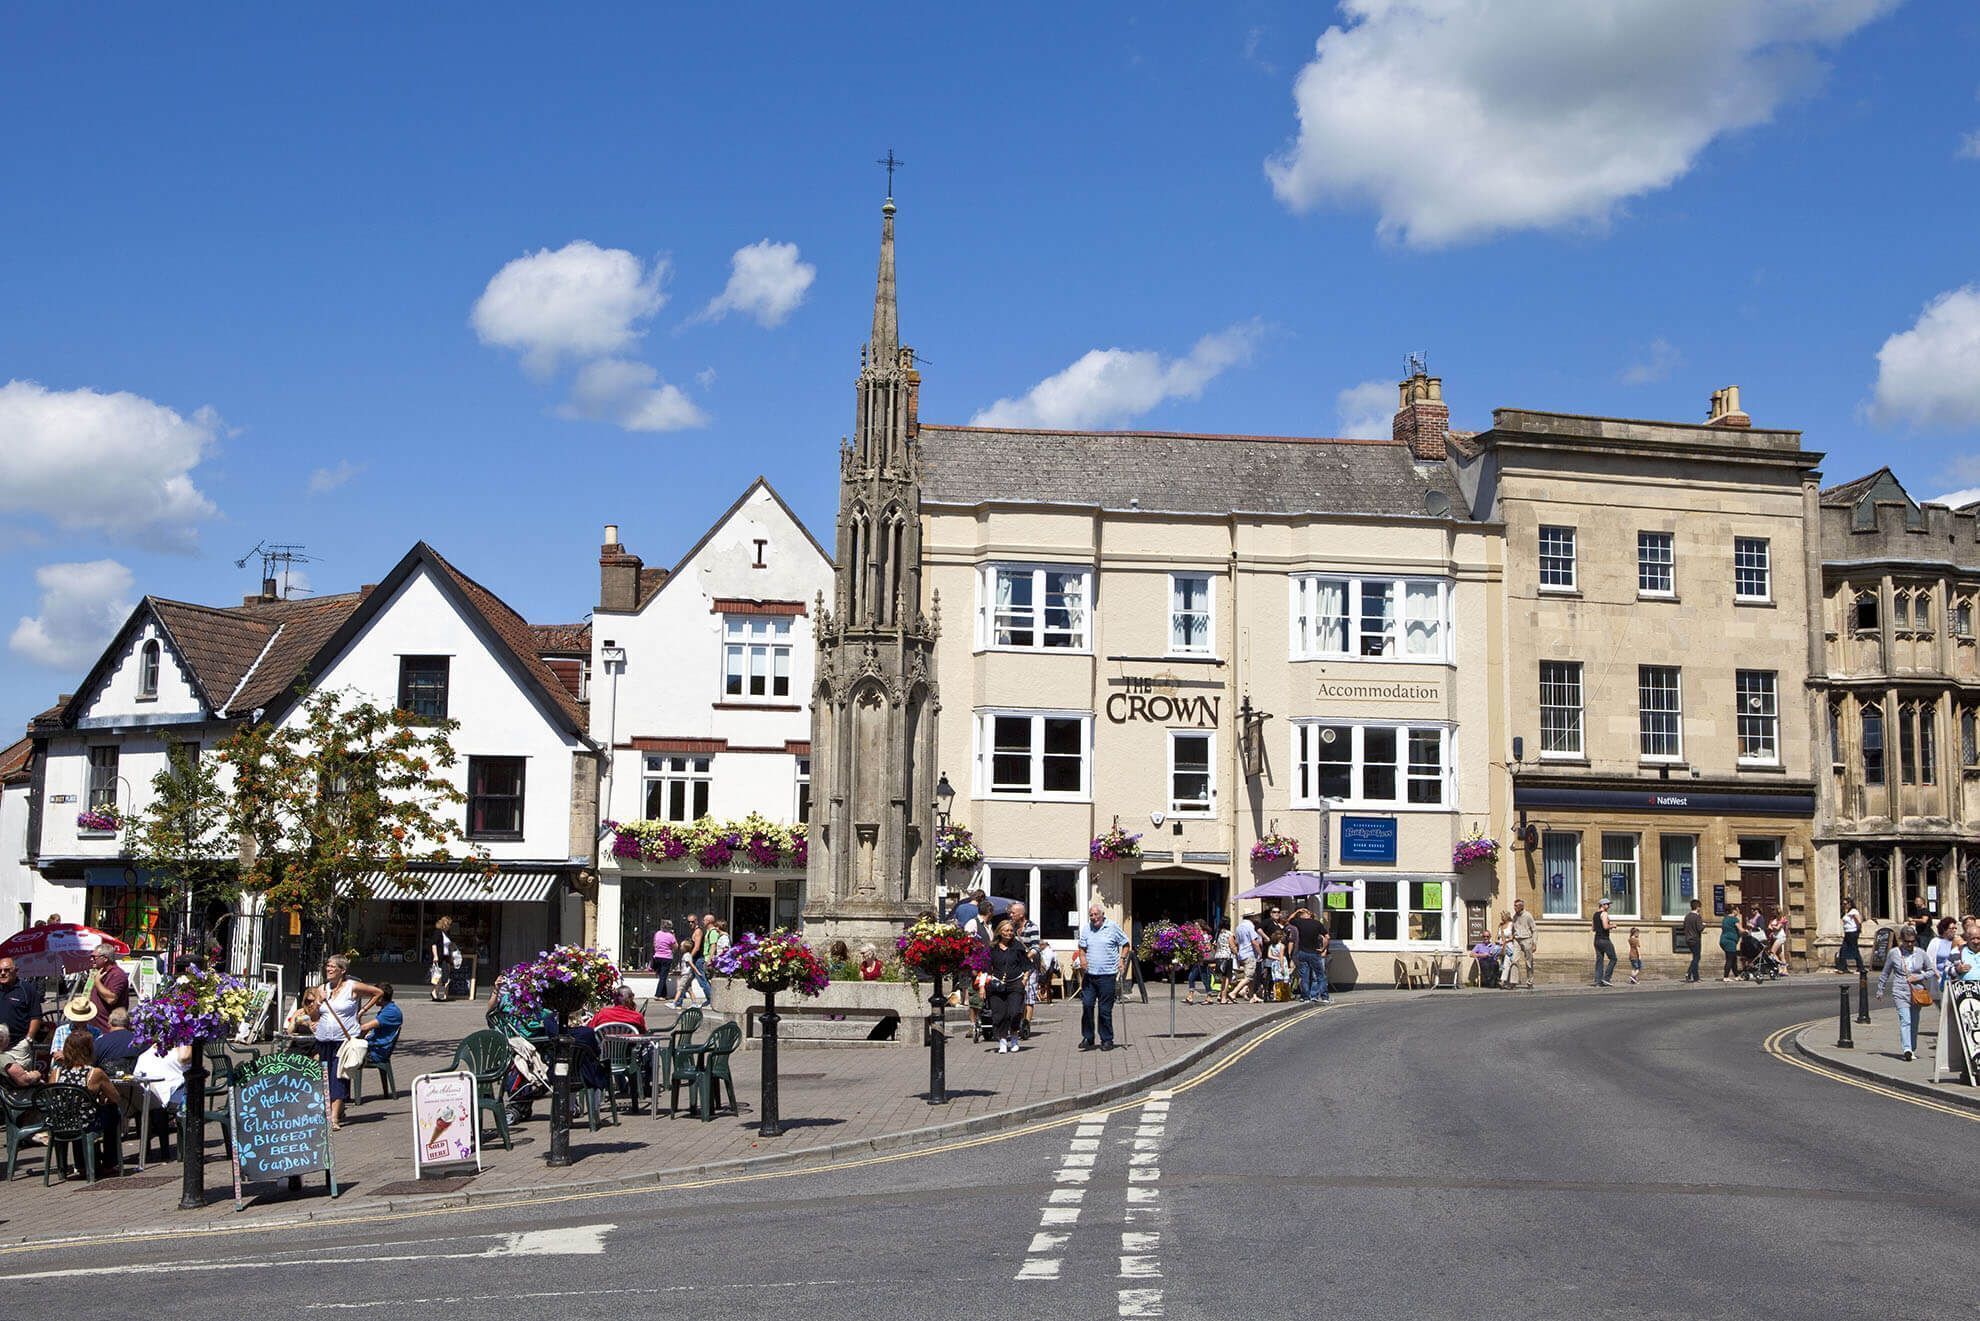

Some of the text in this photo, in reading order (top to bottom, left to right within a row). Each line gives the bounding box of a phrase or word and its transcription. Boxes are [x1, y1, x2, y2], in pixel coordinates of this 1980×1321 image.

[1122, 676, 1152, 694] THE
[1318, 683, 1438, 699] Accommodation
[1106, 693, 1221, 729] CROWN
[1657, 796, 1688, 806] NatWest
[748, 881, 758, 893] 3
[255, 1052, 287, 1067] KING
[241, 1074, 313, 1103] COME AND
[271, 1108, 286, 1119] IN
[254, 1128, 317, 1147] BIGGEST
[270, 1142, 312, 1156] BEER
